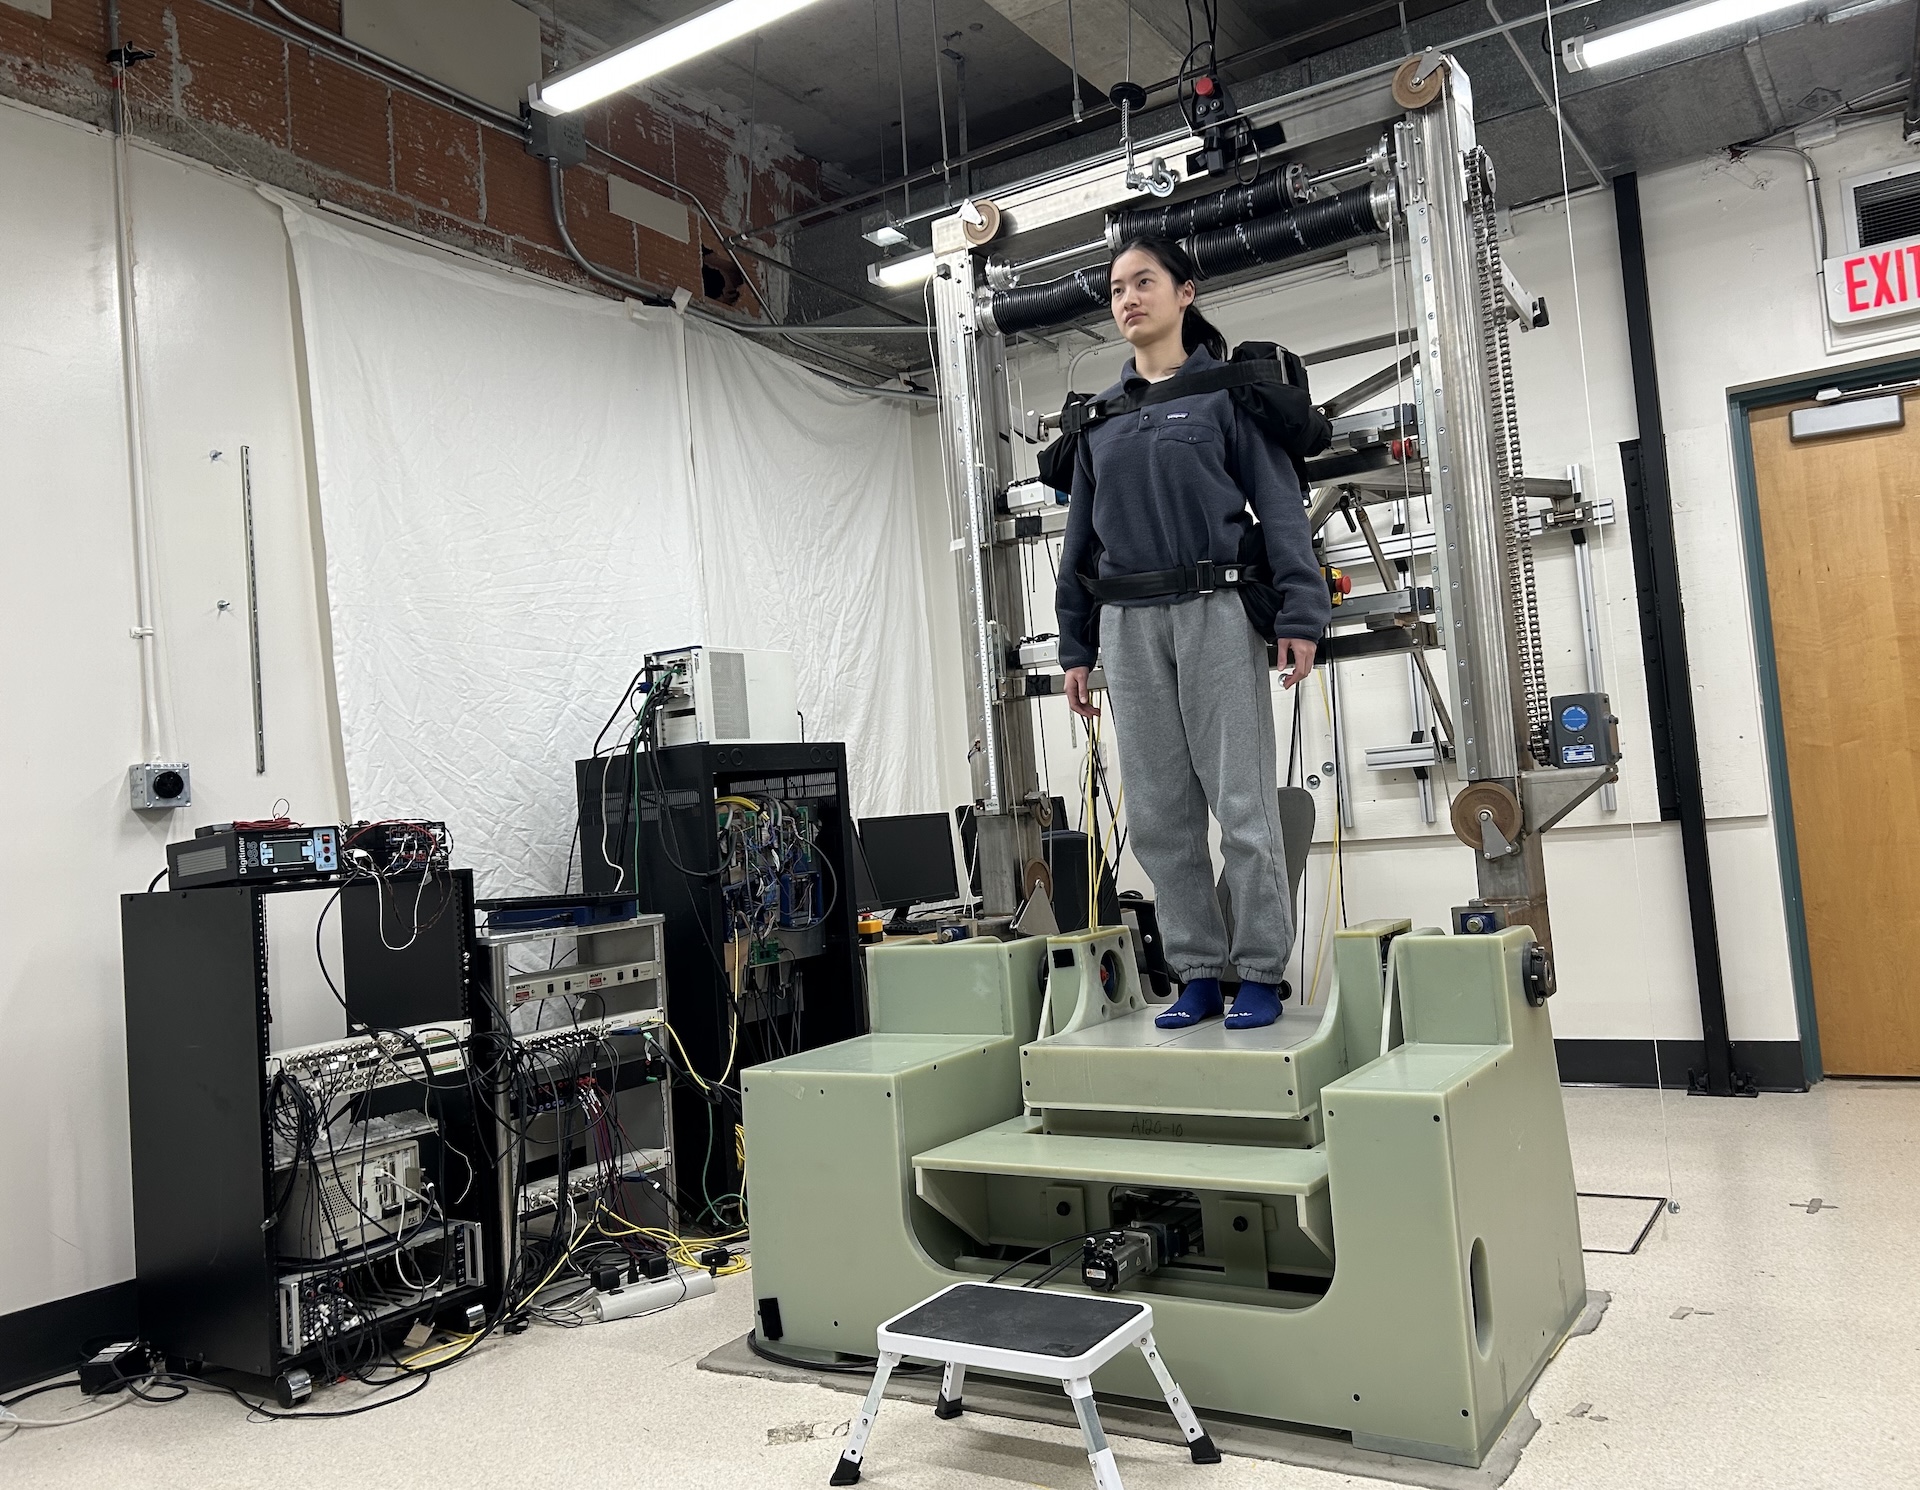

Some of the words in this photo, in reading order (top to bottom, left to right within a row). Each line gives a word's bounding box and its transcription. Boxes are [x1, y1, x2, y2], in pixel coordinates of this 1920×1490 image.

[1843, 244, 1920, 313] EXIT
[238, 836, 248, 875] Digitimer
[246, 840, 259, 868] DS5
